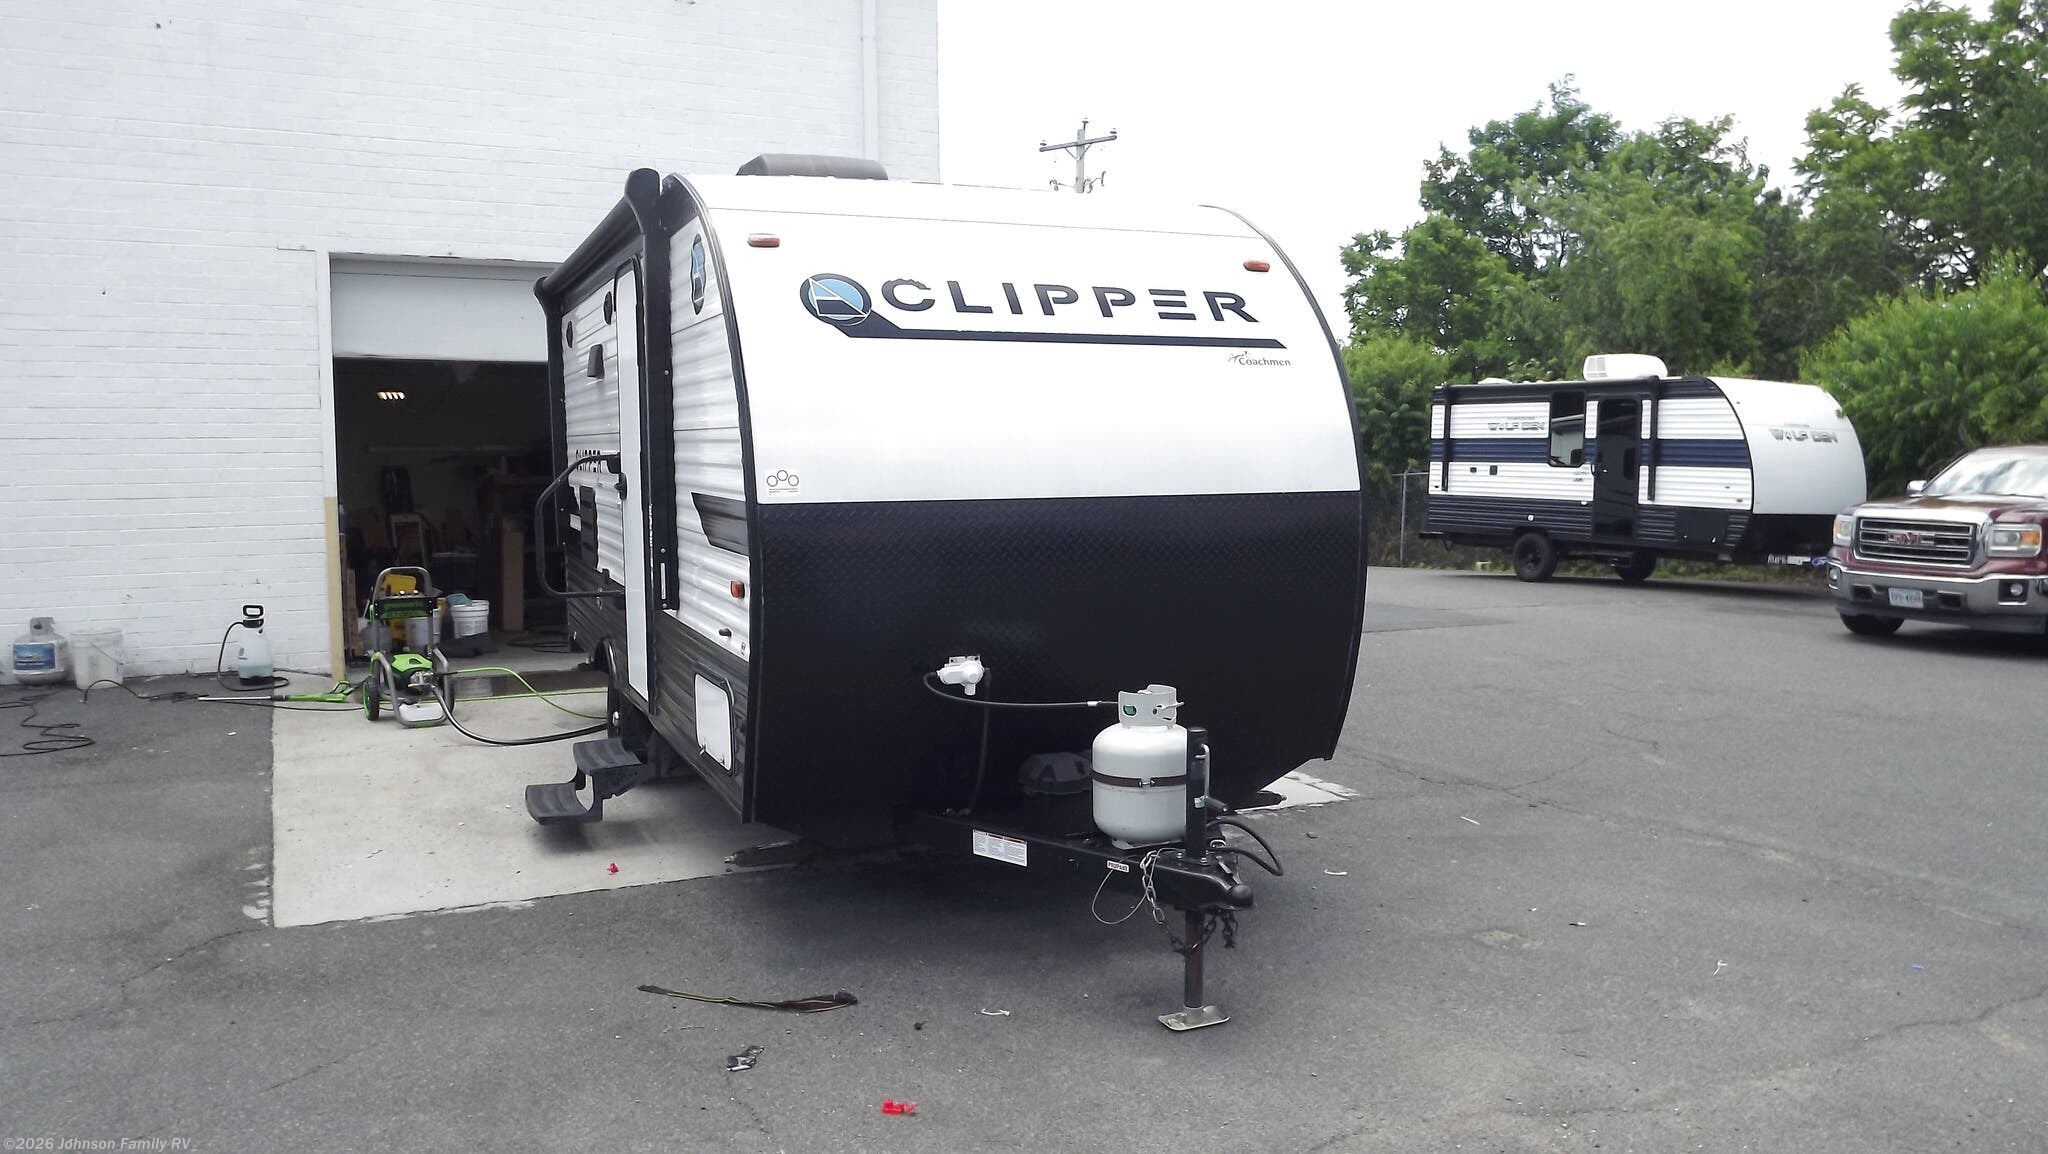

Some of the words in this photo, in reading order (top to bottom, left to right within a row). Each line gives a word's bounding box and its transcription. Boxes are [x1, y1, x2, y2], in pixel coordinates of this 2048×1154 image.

[881, 278, 1259, 322] CLIPPER
[1239, 357, 1291, 366] Coachmen
[1887, 530, 1935, 545] GMC
